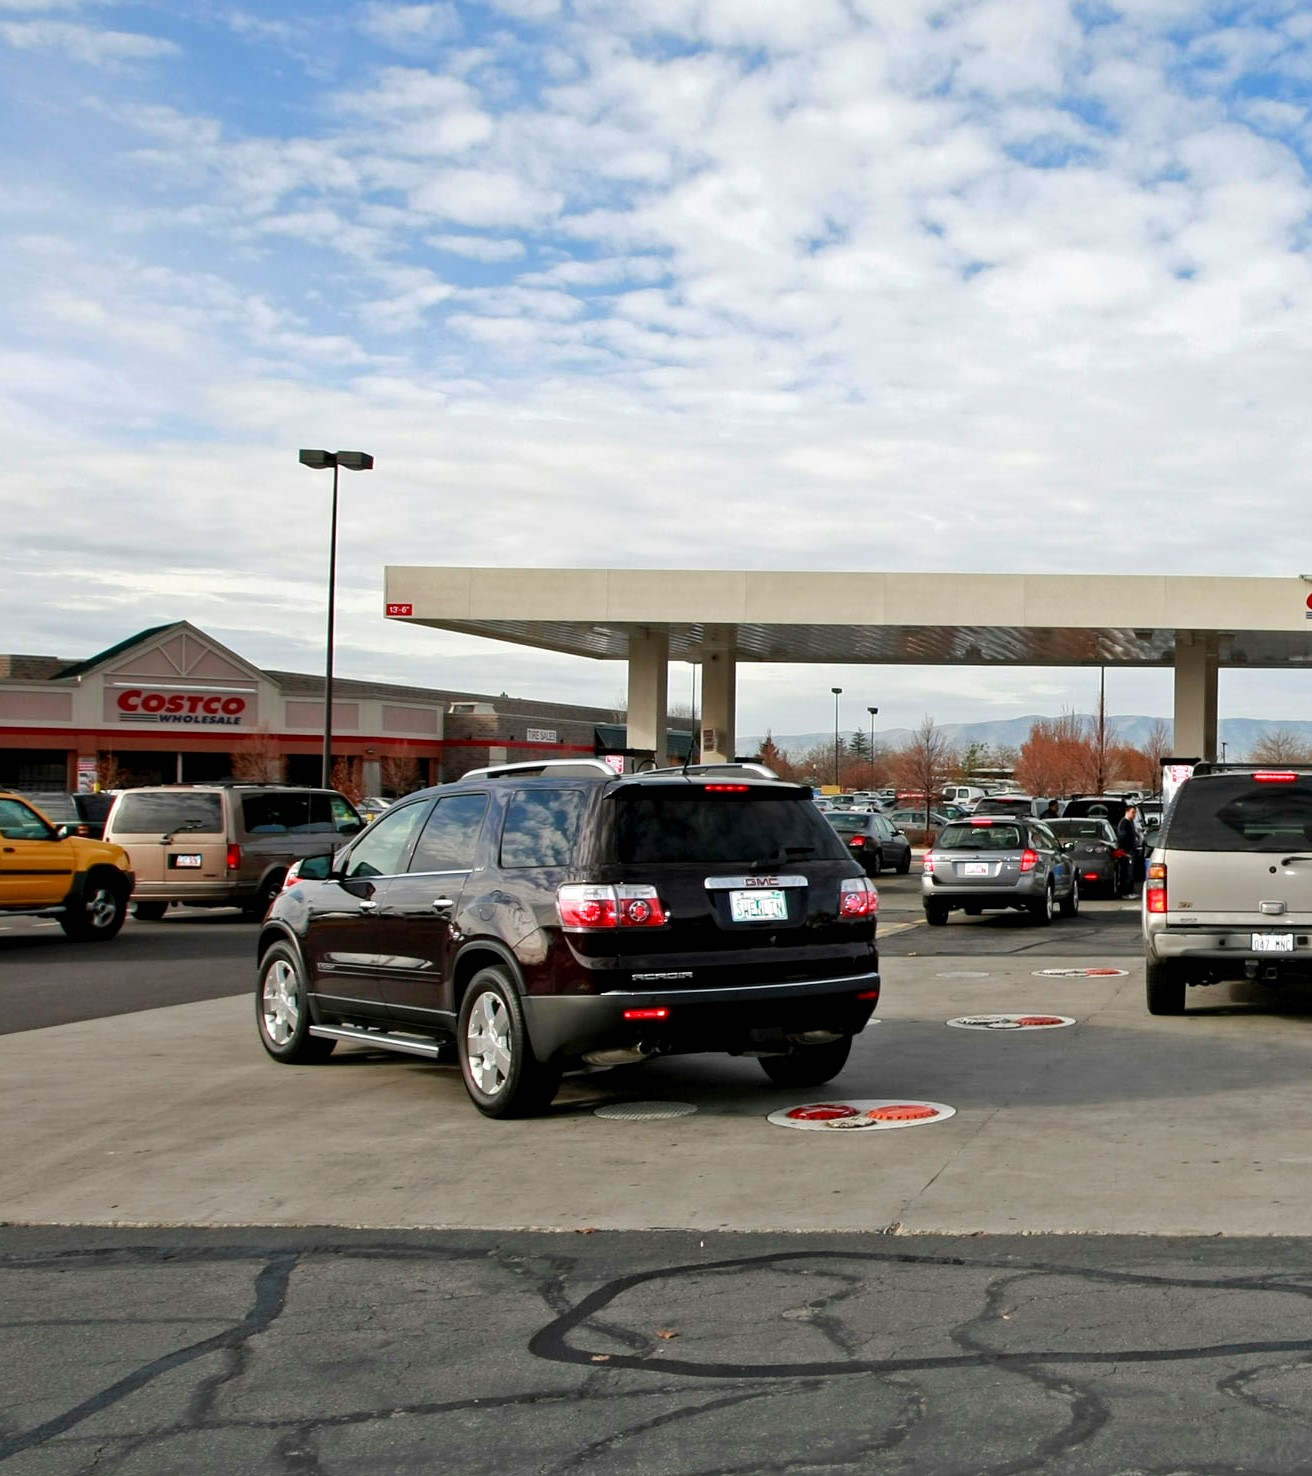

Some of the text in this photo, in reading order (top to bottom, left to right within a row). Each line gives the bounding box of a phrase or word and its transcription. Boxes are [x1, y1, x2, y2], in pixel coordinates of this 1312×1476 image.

[117, 689, 245, 715] COSTCO
[158, 714, 241, 725] WHOLESALE
[528, 730, 556, 741] TIRE SALES
[745, 877, 779, 887] GMC
[631, 971, 693, 981] ACADIA
